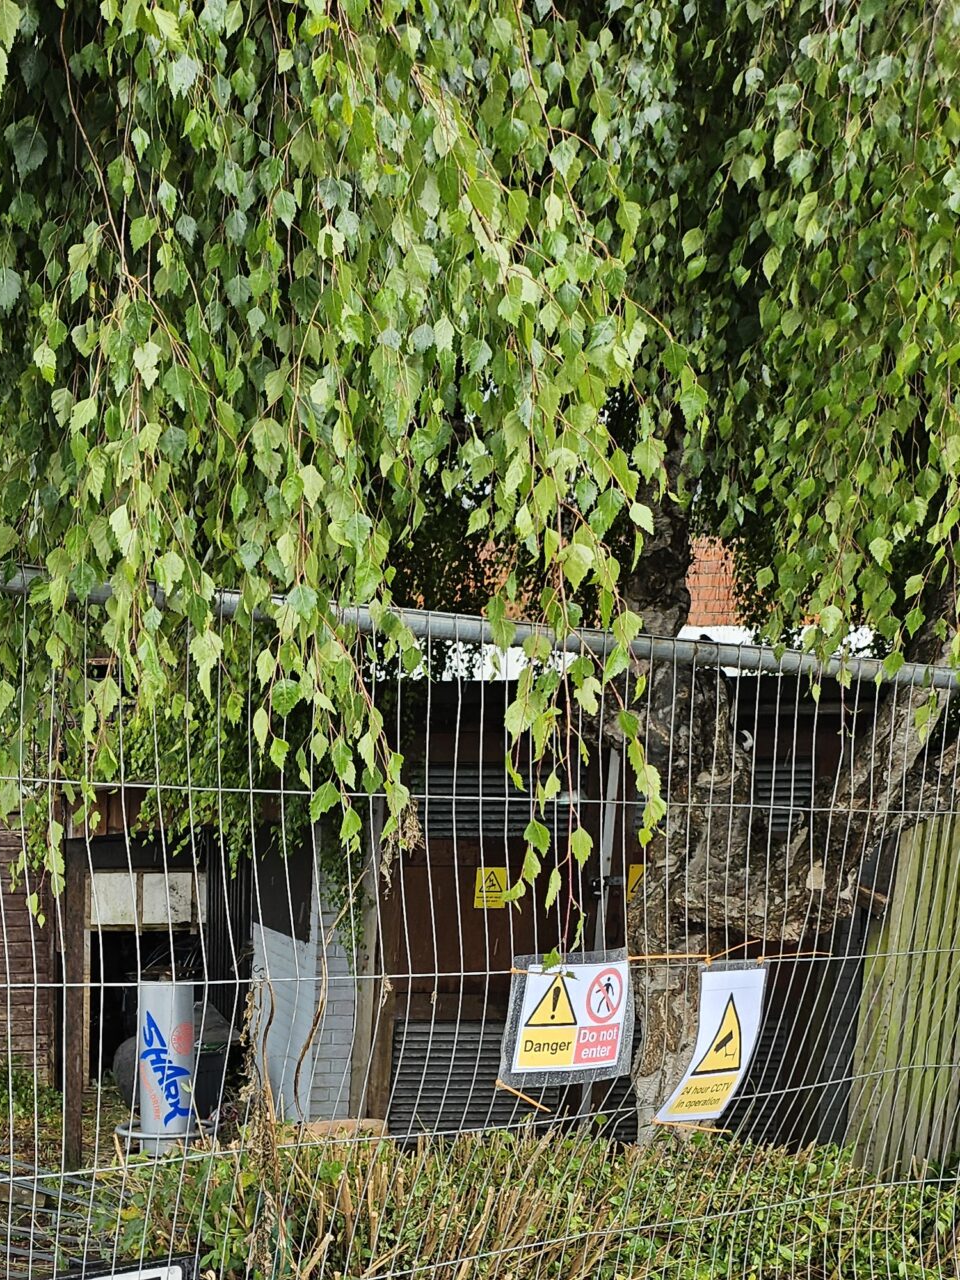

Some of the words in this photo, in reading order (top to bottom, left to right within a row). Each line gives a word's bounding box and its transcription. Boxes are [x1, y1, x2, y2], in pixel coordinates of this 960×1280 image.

[579, 1029, 597, 1043] Do
[599, 1027, 618, 1041] not
[523, 1039, 572, 1055] Danger
[581, 1045, 611, 1059] enter
[140, 1010, 194, 1127] SHARK
[680, 1085, 693, 1096] 24
[691, 1085, 711, 1095] hour
[710, 1081, 733, 1094] CCTV
[685, 1097, 721, 1110] operation
